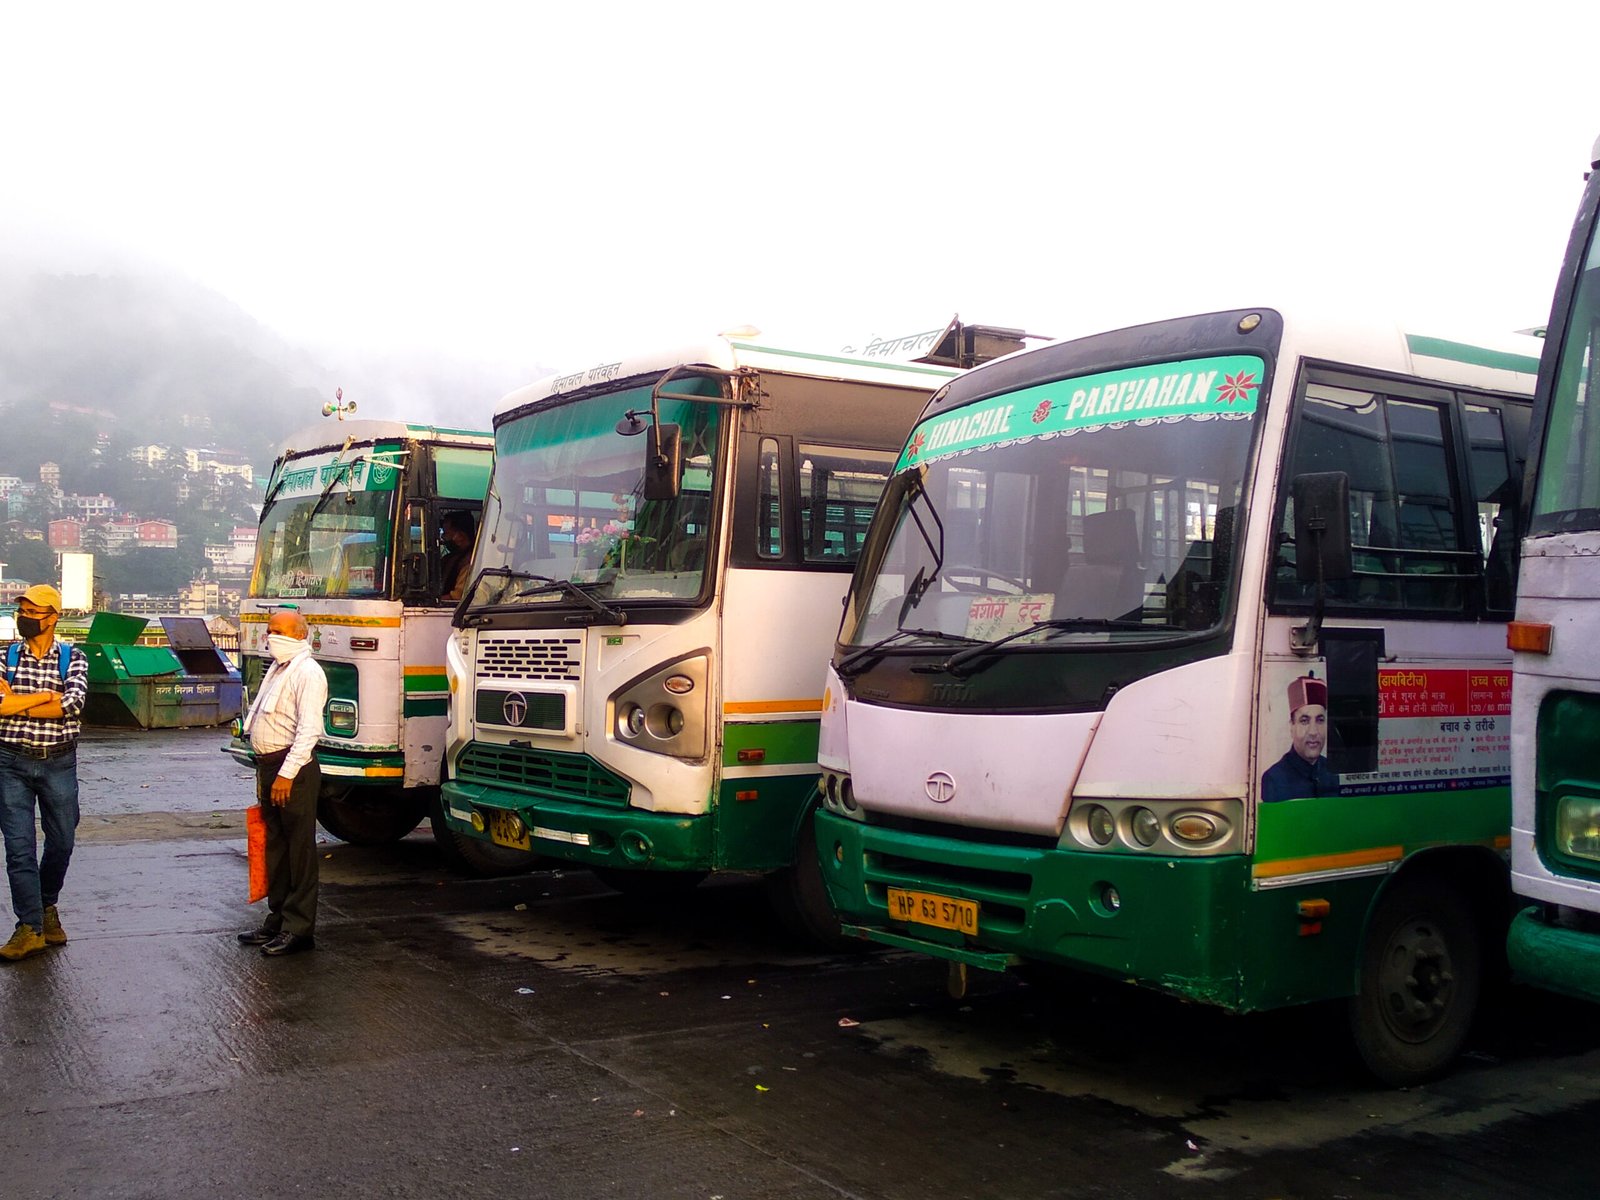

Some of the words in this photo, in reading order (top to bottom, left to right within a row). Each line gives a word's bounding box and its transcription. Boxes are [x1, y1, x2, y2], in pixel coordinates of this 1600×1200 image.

[926, 404, 1015, 452] HIMACHAL
[1064, 370, 1218, 421] PARIVAHAN
[1378, 672, 1427, 689] (डायबिटीज)
[1440, 721, 1460, 732] बचाव
[1463, 719, 1471, 731] के
[1475, 717, 1495, 731] तरीके
[897, 895, 915, 916] HP
[921, 898, 937, 920] 63
[942, 902, 973, 929] 5710
